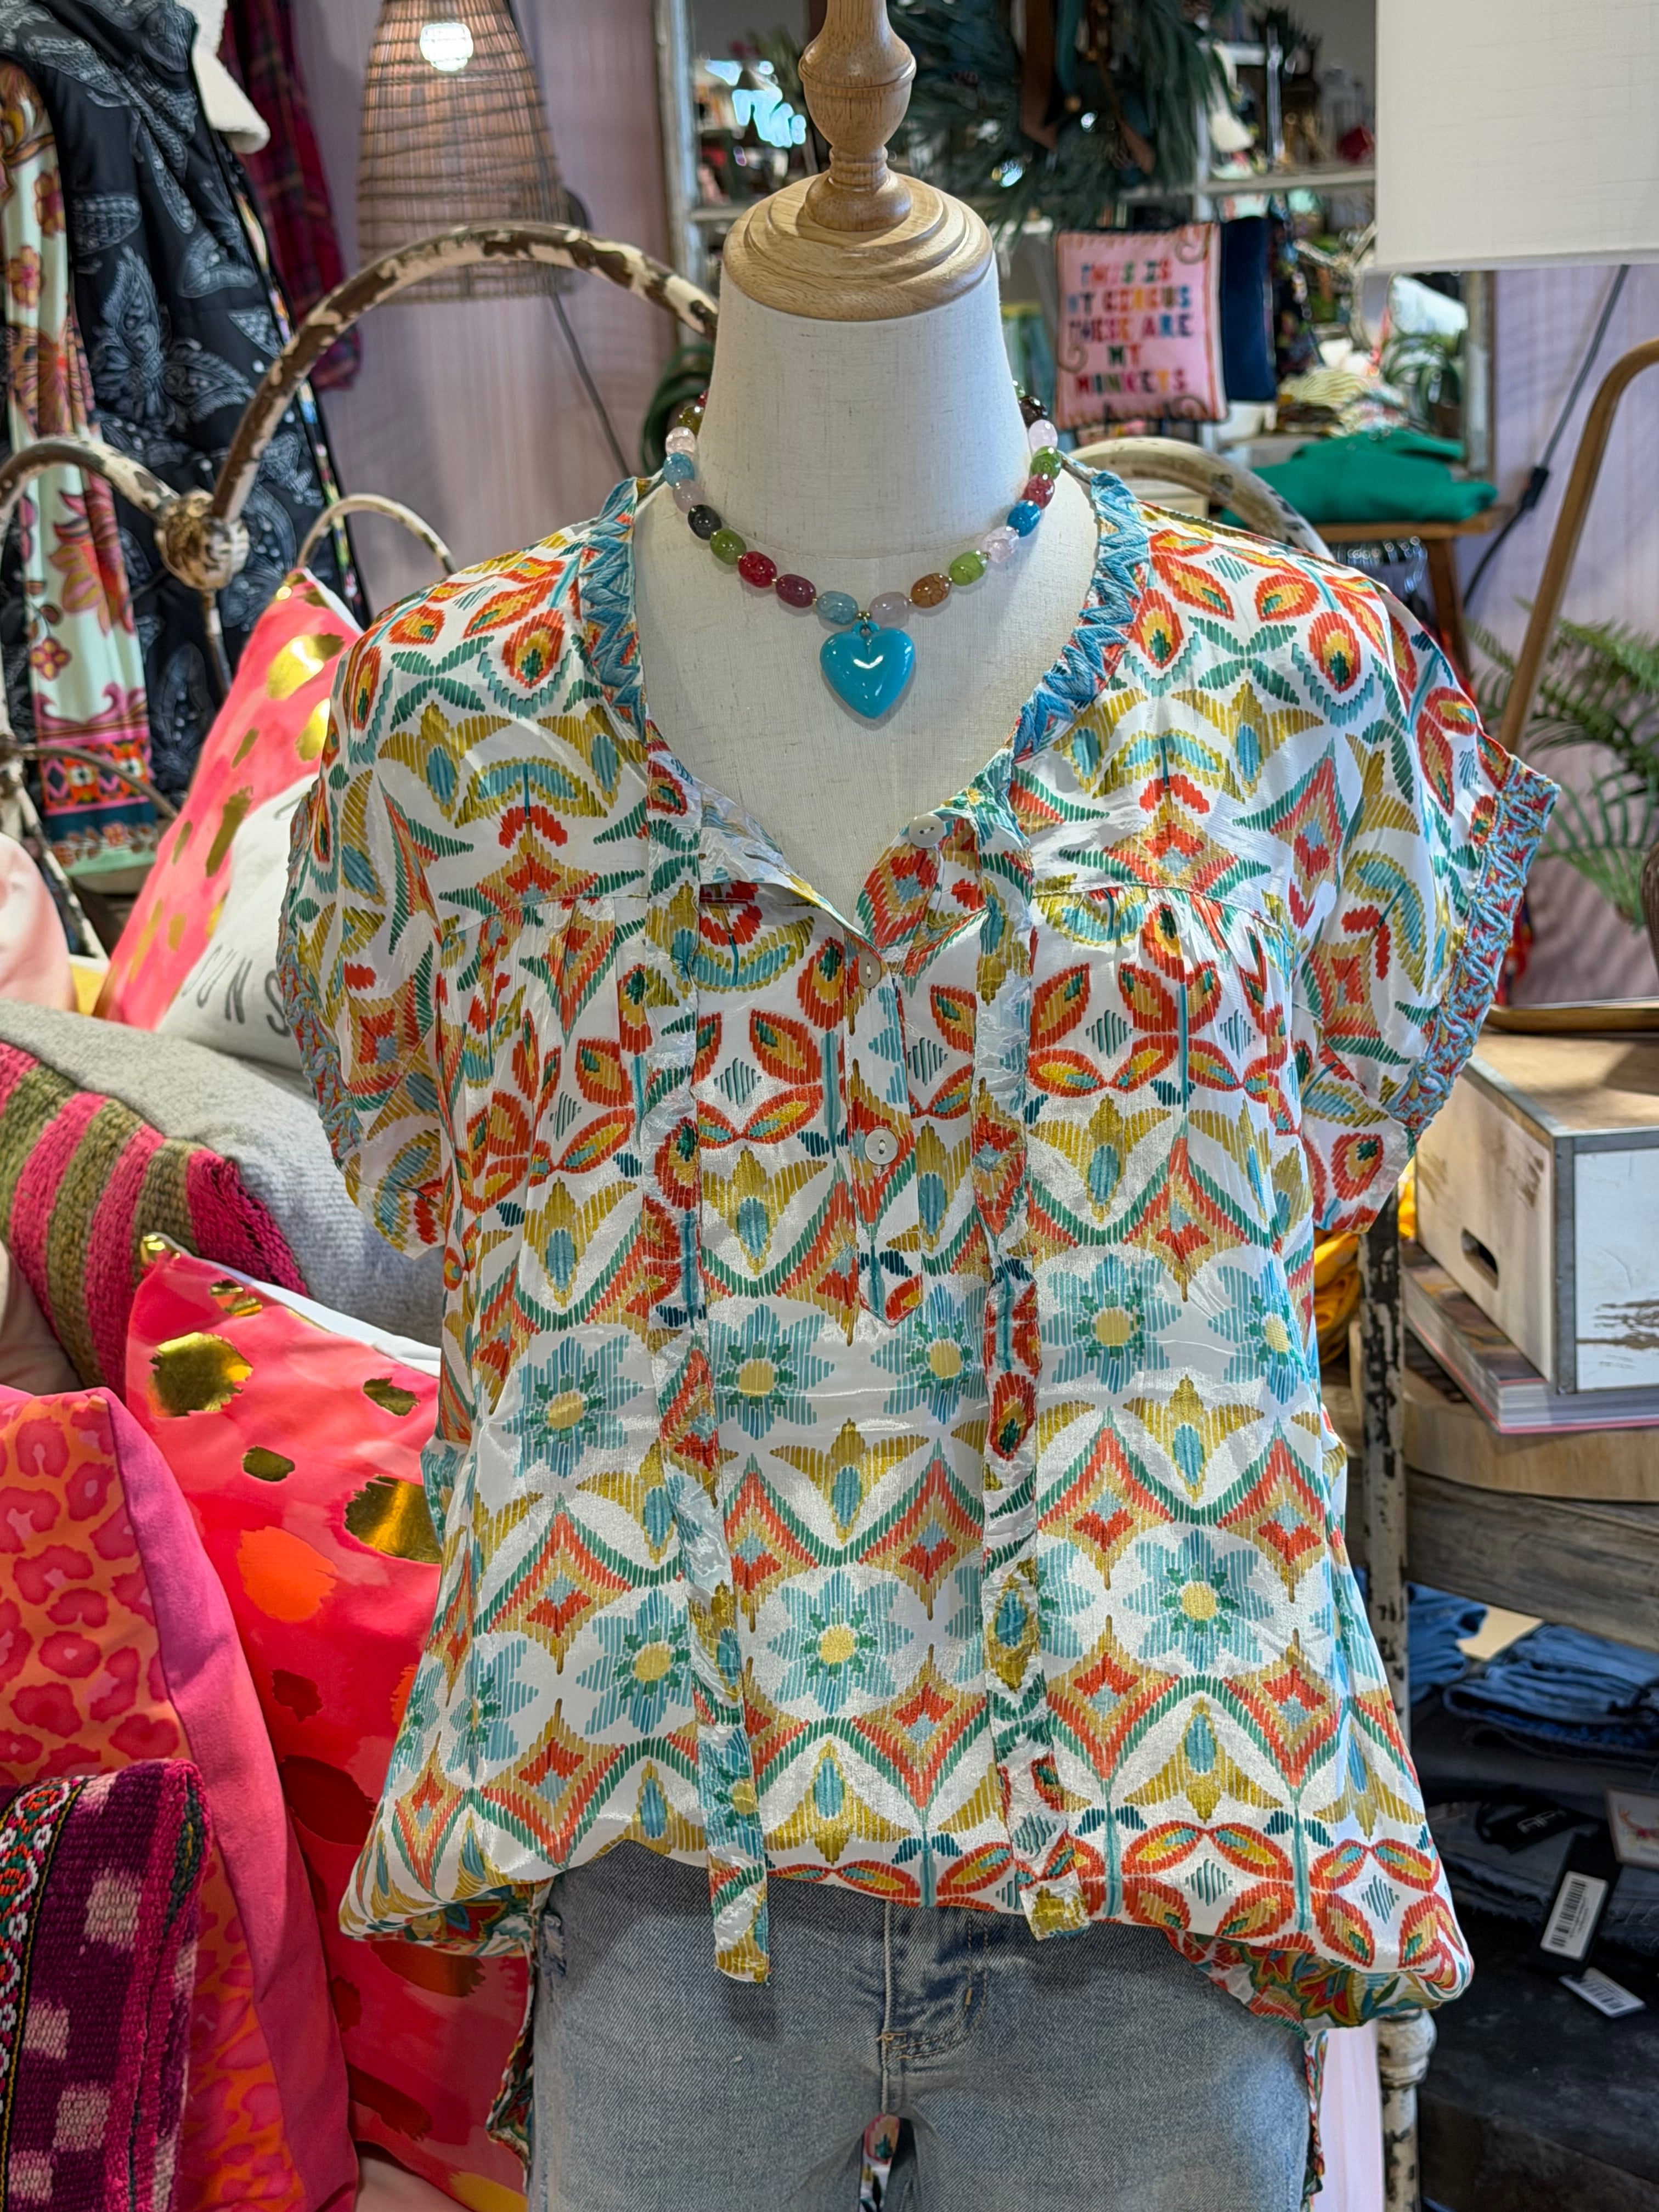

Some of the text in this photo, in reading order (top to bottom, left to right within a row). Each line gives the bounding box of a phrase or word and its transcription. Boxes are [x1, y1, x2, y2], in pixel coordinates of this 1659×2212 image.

[1143, 259, 1172, 284] IS
[1103, 285, 1191, 313] CIRCUS
[1142, 313, 1193, 338] ARE
[1108, 344, 1143, 367] MY
[1075, 369, 1187, 395] MONKEYS
